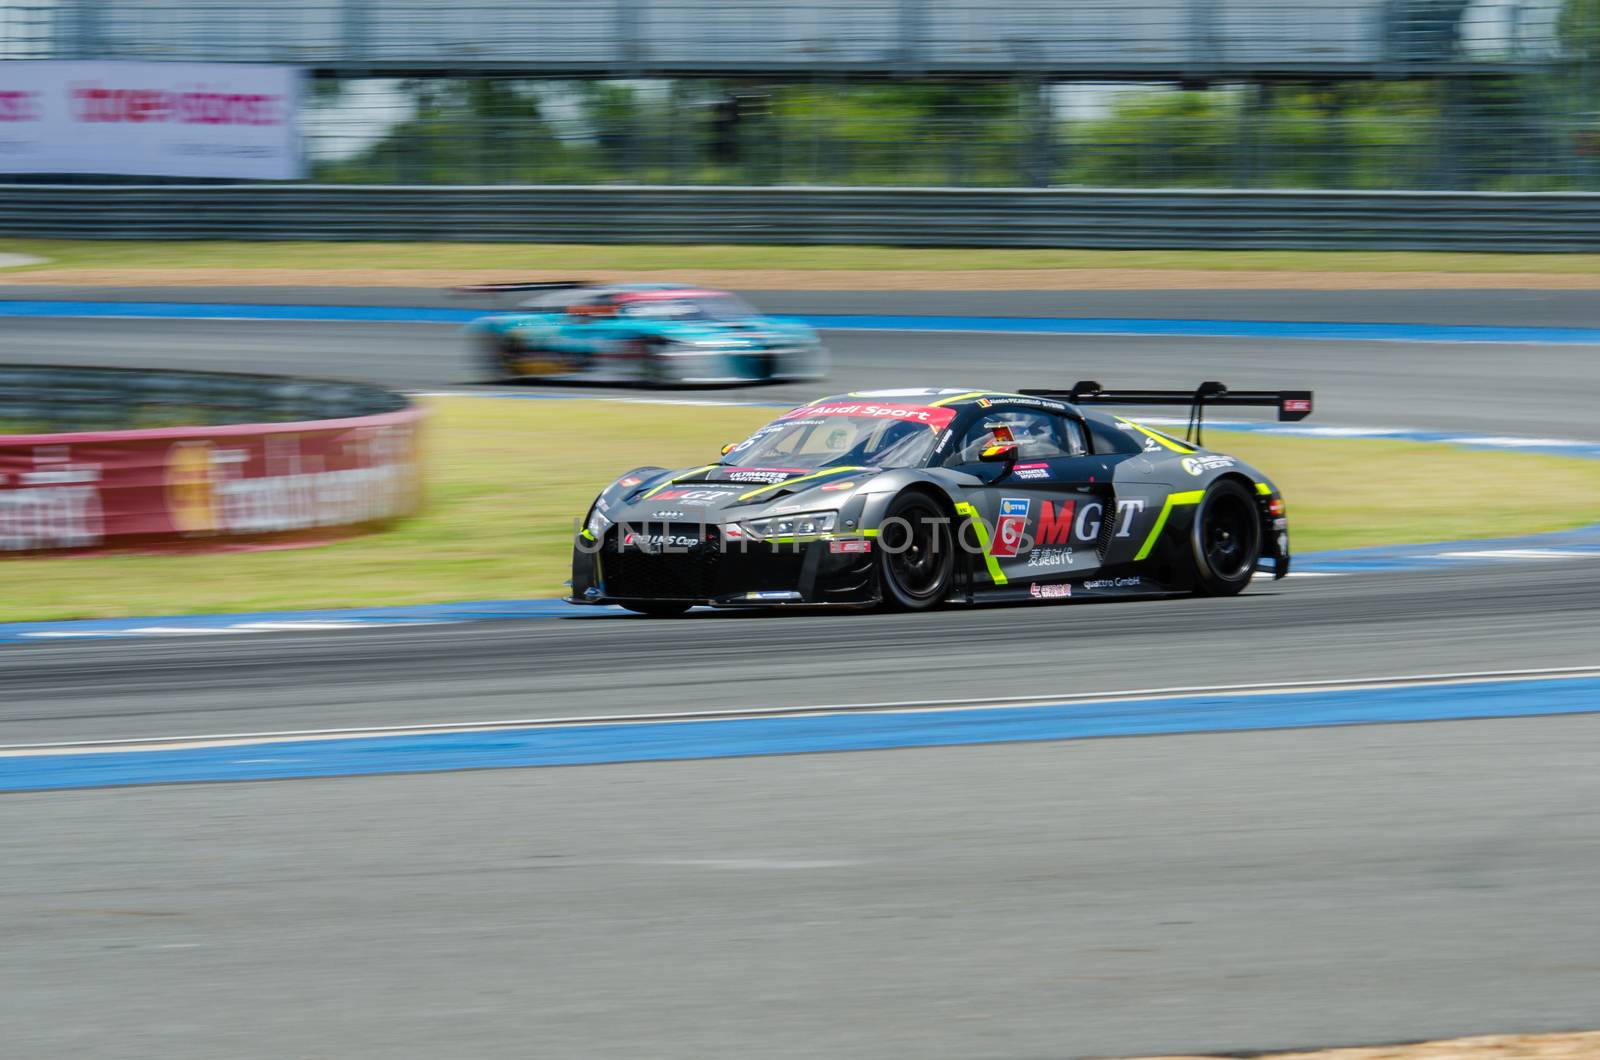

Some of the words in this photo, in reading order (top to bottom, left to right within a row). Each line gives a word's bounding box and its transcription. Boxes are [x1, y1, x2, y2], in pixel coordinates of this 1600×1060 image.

[809, 404, 859, 415] Audi
[861, 405, 931, 421] Sport
[1002, 518, 1017, 545] 6
[676, 536, 699, 548] Cup
[1083, 577, 1114, 590] quattro
[1115, 576, 1141, 587] GmbH
